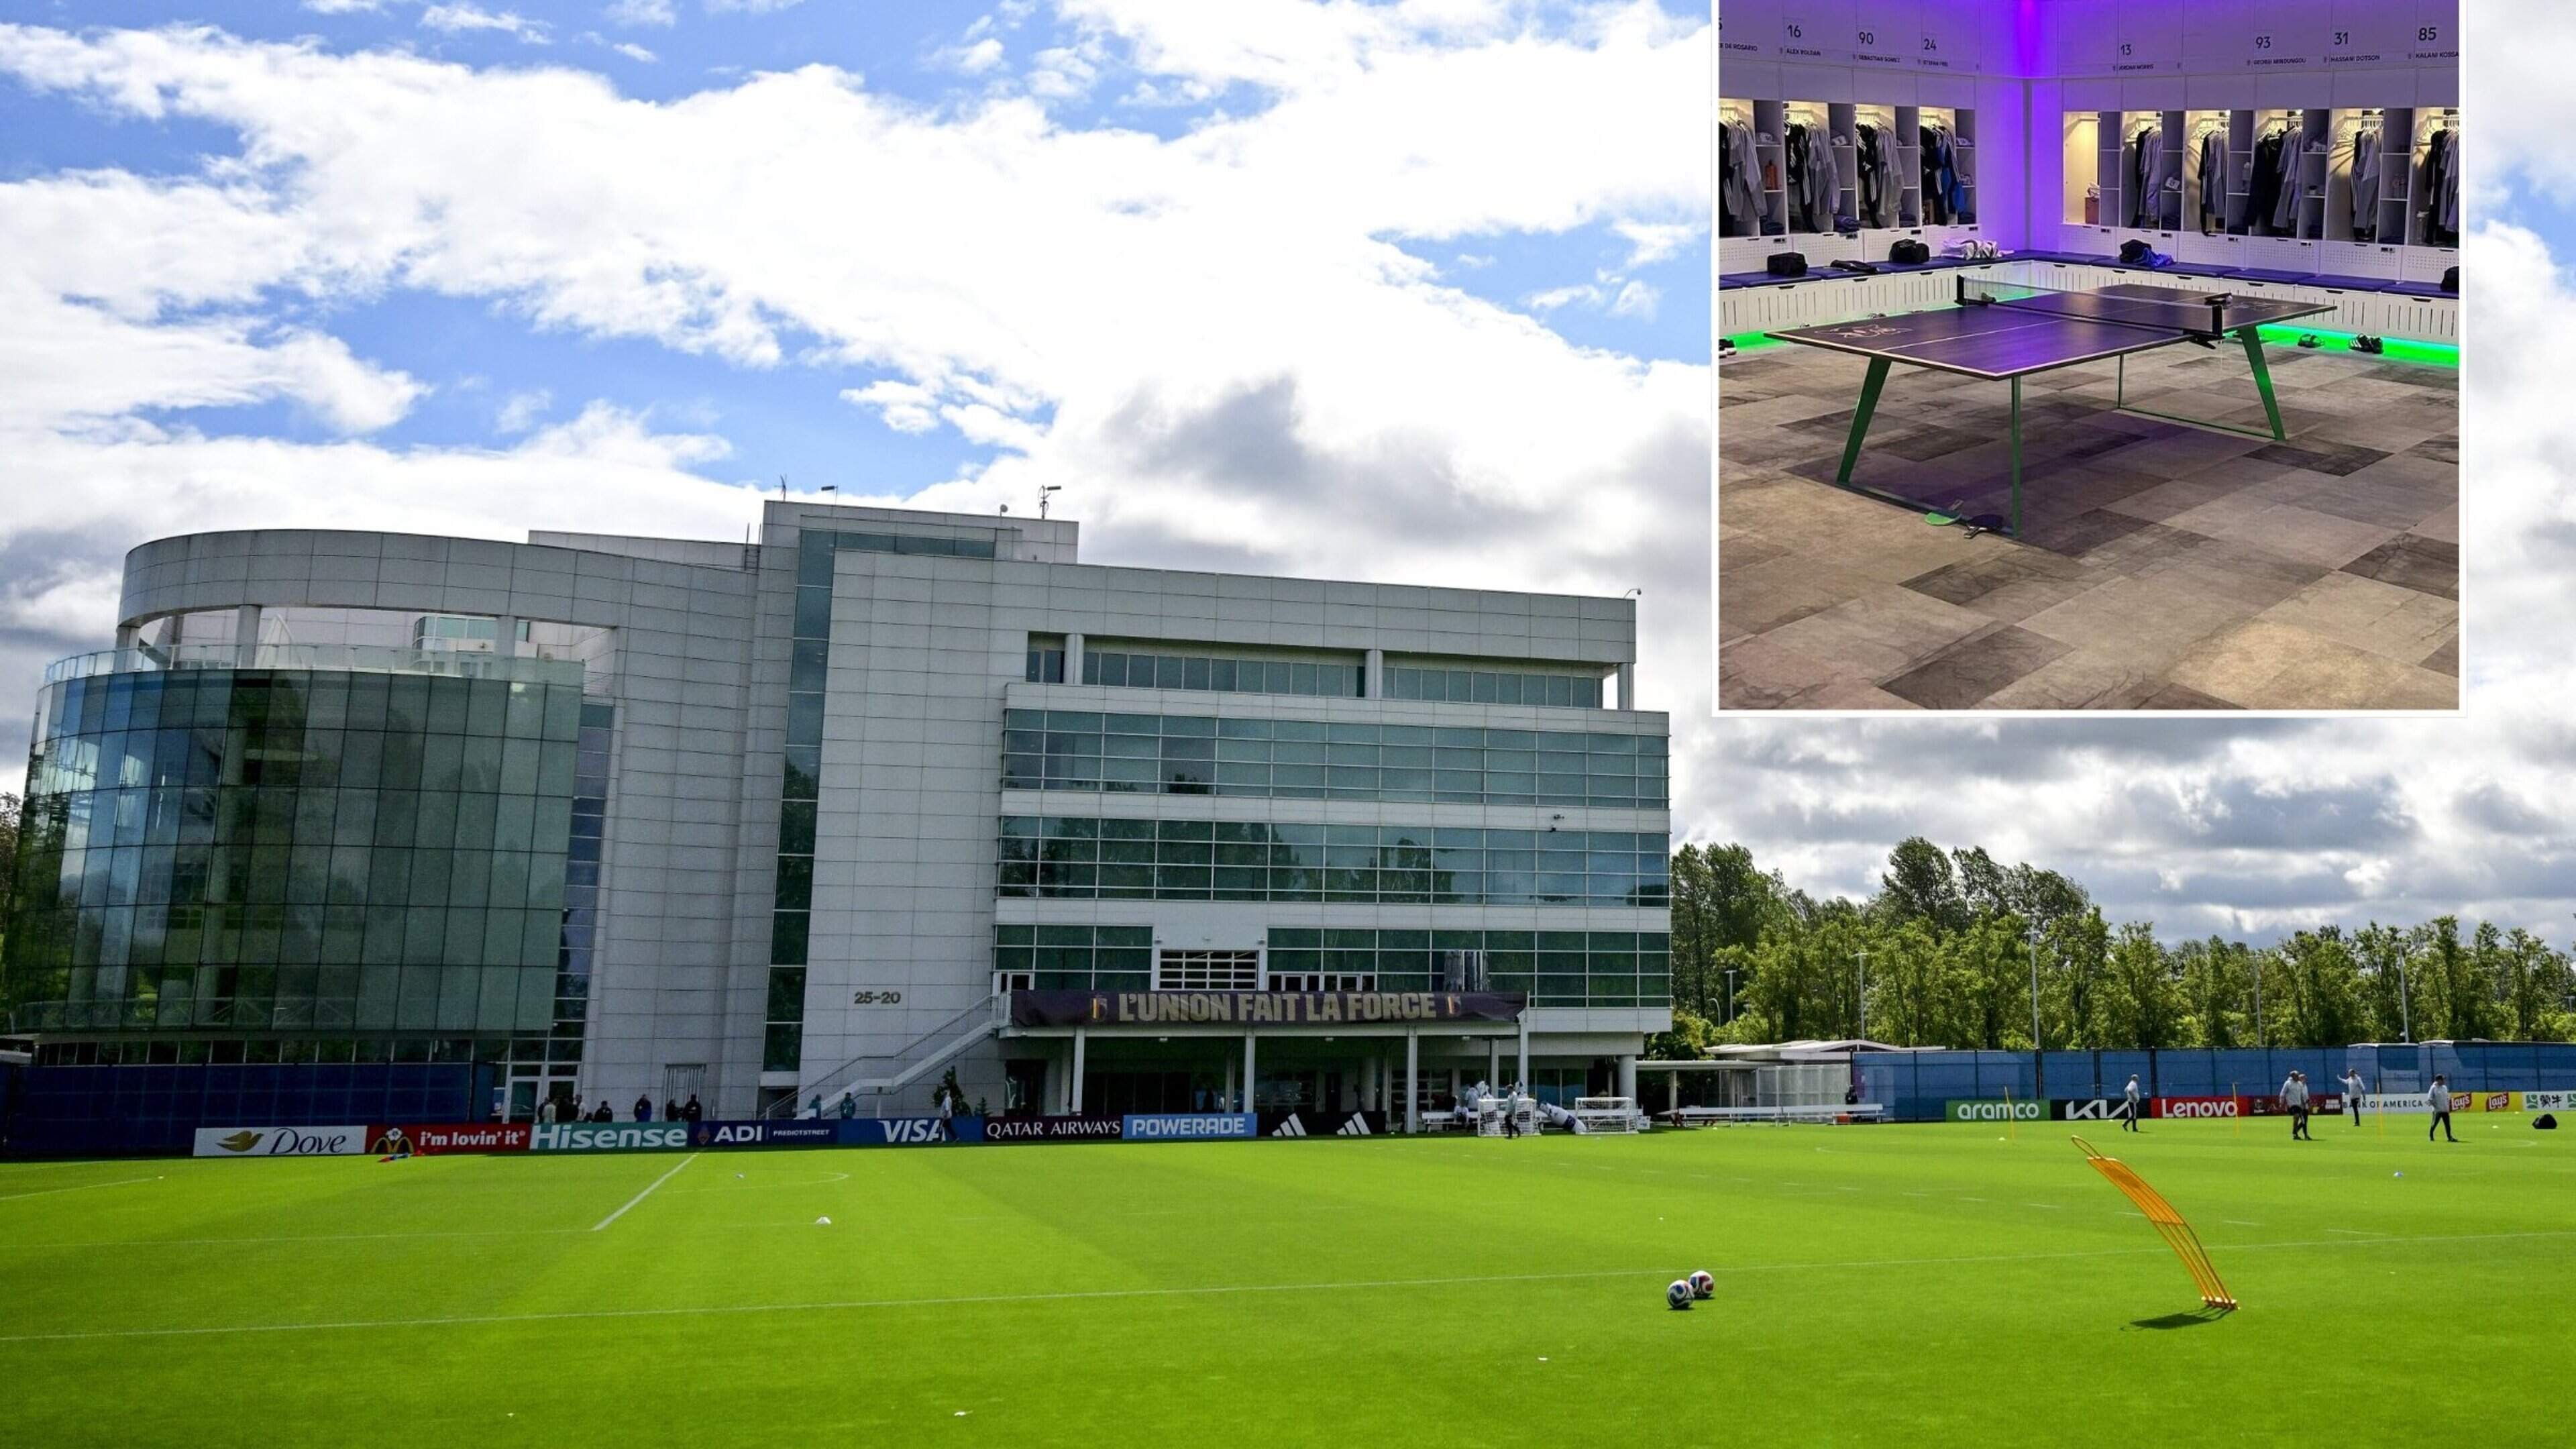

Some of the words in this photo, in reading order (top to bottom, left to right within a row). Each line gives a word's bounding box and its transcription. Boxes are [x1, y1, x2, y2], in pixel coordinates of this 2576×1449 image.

[1787, 24, 1802, 38] 16
[1858, 32, 1874, 45] 90
[2334, 32, 2349, 45] 31
[2418, 27, 2437, 41] 85
[1923, 38, 1937, 50] 24
[2121, 44, 2131, 55] 13
[2255, 36, 2271, 48] 93
[854, 991, 901, 1004] 25-20
[1118, 993, 1231, 1022] L'UNION
[1238, 993, 1299, 1022] FAIT
[1305, 993, 1340, 1022] LA
[1347, 992, 1436, 1021] FORCE
[1957, 1103, 2039, 1120] aramco
[2161, 1098, 2237, 1118] Lenovo
[2383, 1099, 2423, 1108] AMERICA
[714, 1125, 763, 1142] ADI
[877, 1119, 947, 1143] VISA
[987, 1122, 1043, 1138] QATAR
[1051, 1121, 1120, 1134] AIRWAYS
[1132, 1117, 1246, 1136] POWERADE
[270, 1127, 347, 1155] Dove
[420, 1131, 447, 1146] i'm
[451, 1130, 502, 1146] lovin'
[529, 1124, 688, 1150] Hisense
